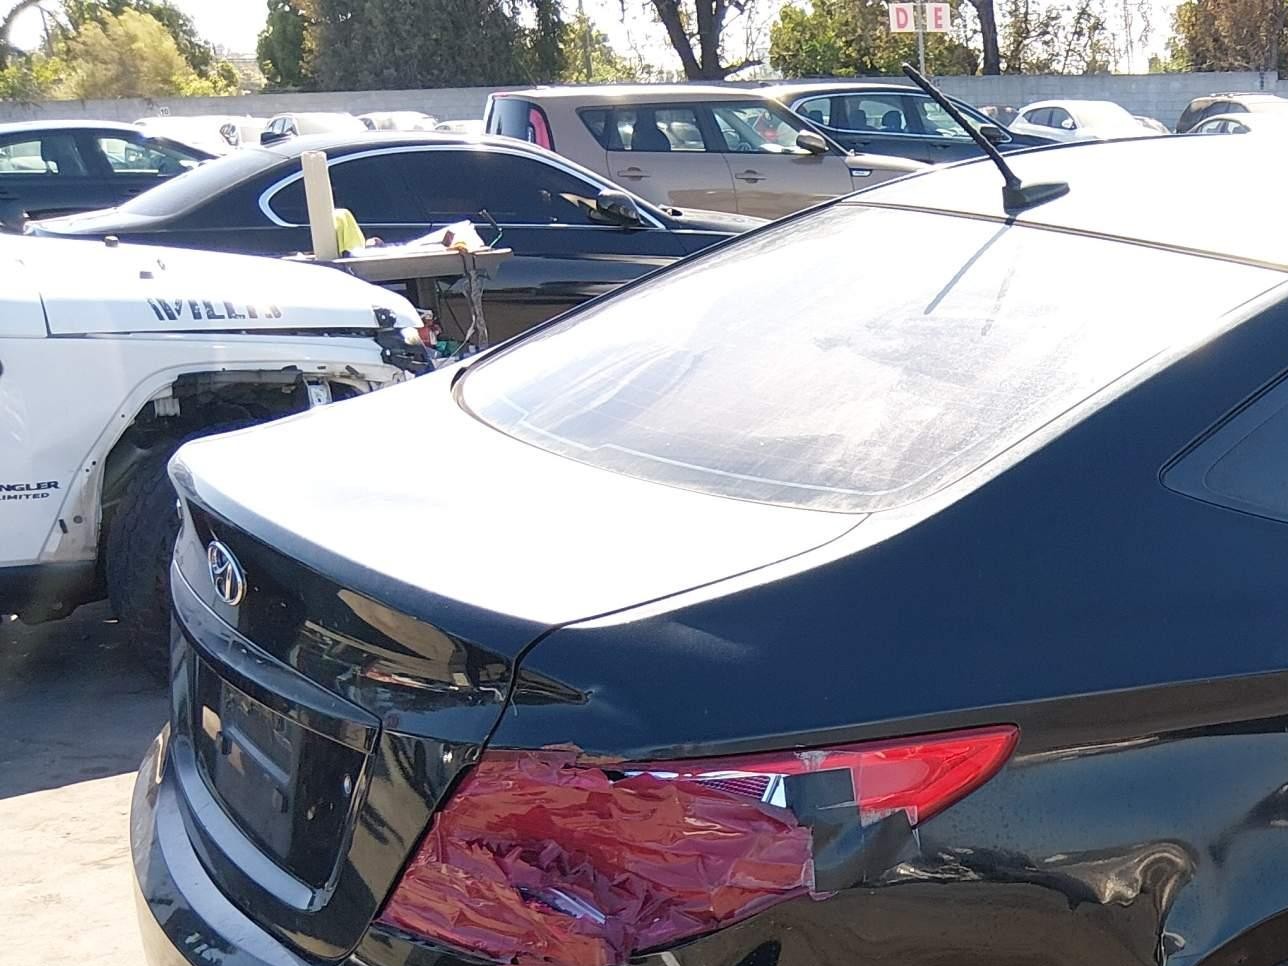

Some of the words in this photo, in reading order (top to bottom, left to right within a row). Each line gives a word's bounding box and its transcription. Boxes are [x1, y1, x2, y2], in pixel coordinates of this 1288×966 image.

[895, 7, 908, 28] D
[934, 7, 943, 28] E
[0, 492, 50, 500] IMITED
